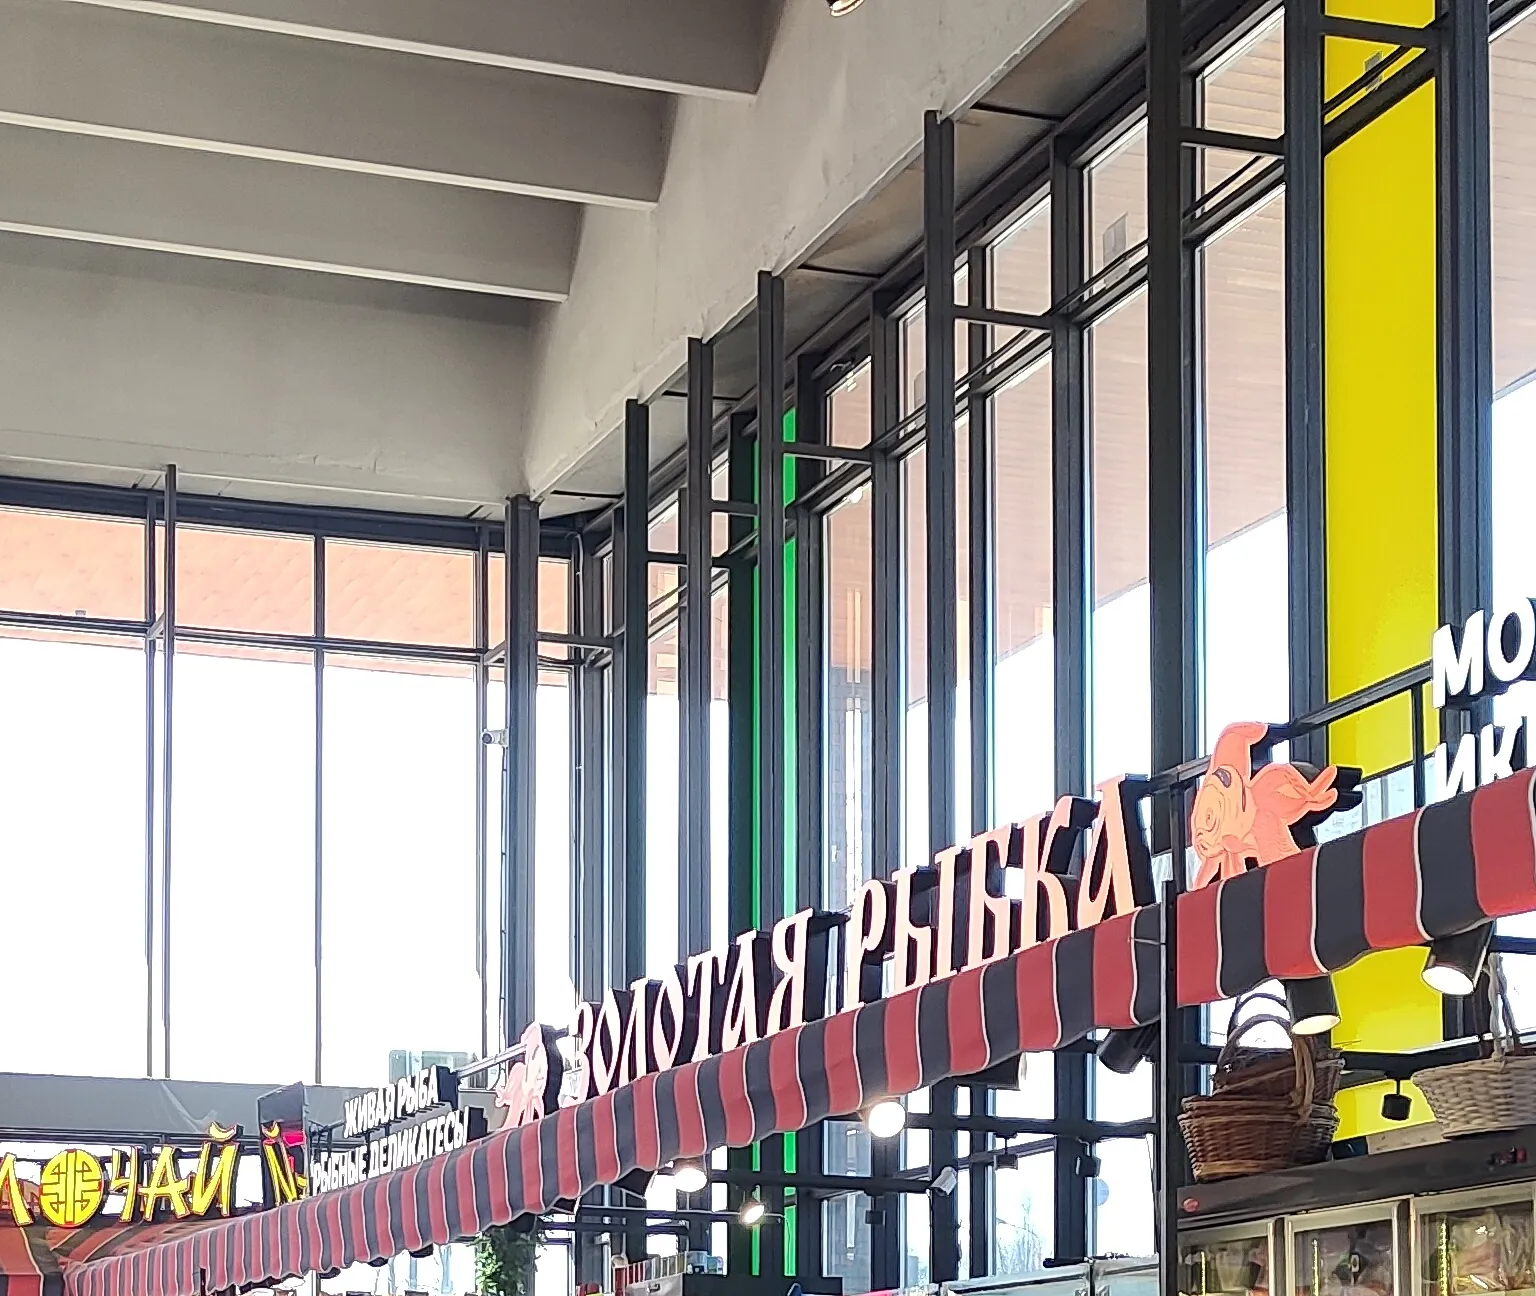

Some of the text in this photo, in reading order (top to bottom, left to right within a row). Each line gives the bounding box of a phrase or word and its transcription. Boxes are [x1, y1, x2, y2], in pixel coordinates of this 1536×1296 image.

[568, 772, 1140, 1106] ЗОЛОТАЯ РЫБКА
[343, 1064, 439, 1138] ЖИВАЯ РЫБА
[108, 1121, 241, 1223] ЧАЙ
[311, 1144, 368, 1194] РЫБНЫЕ
[368, 1106, 469, 1179] ДЕЛИКАТЕСЫ
